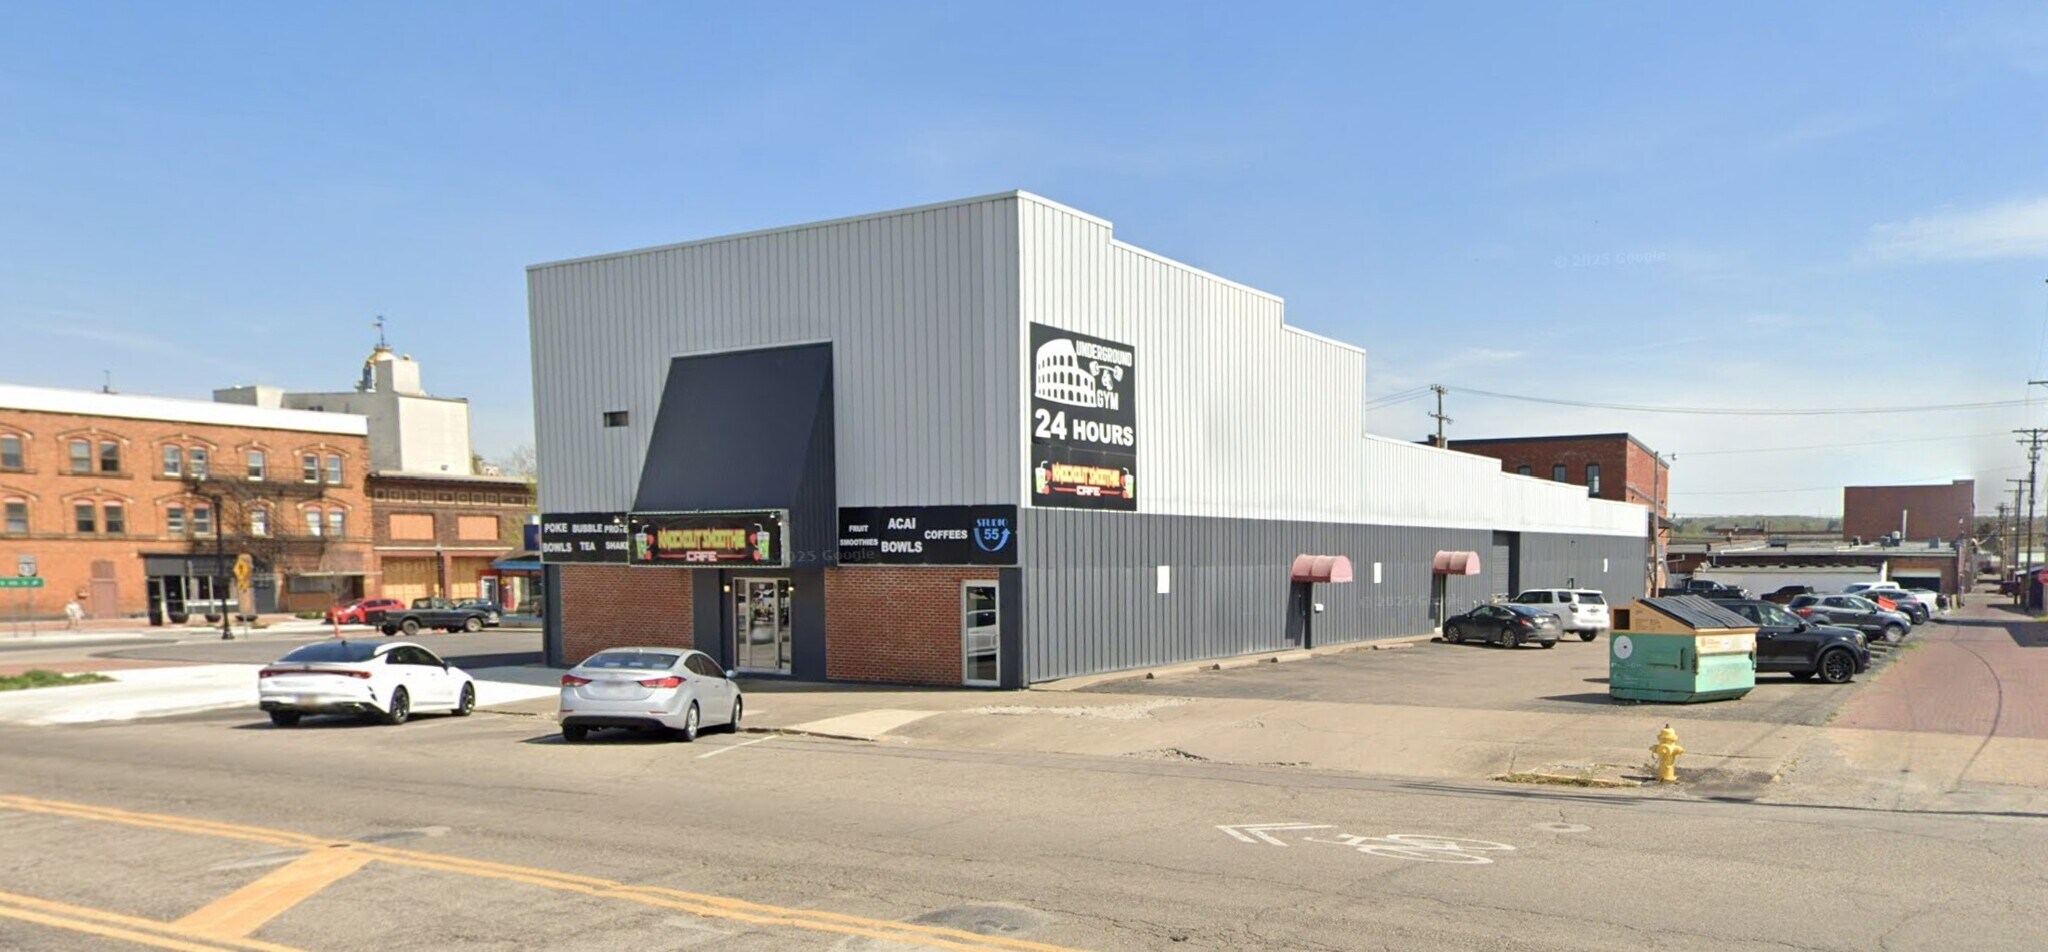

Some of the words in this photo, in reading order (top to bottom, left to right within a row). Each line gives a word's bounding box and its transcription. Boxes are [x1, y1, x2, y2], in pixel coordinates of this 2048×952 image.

[1076, 340, 1132, 367] UNDERGROUND
[1097, 389, 1119, 410] GYM
[1035, 409, 1067, 440] 24
[1073, 419, 1134, 447] HOURS
[1076, 485, 1101, 496] CAFE
[887, 517, 916, 530] ACAI
[976, 518, 1008, 527] STUDIO
[544, 523, 568, 533] POKE
[572, 524, 603, 533] BUBBLE
[849, 524, 869, 533] FRUIT
[924, 530, 967, 540] COFFEES
[984, 528, 1000, 540] 55
[543, 542, 572, 552] BOWLS
[580, 541, 596, 551] TEA
[839, 538, 879, 546] SMOOTHIES
[881, 541, 923, 553] BOWLS
[686, 551, 717, 561] CAFE
